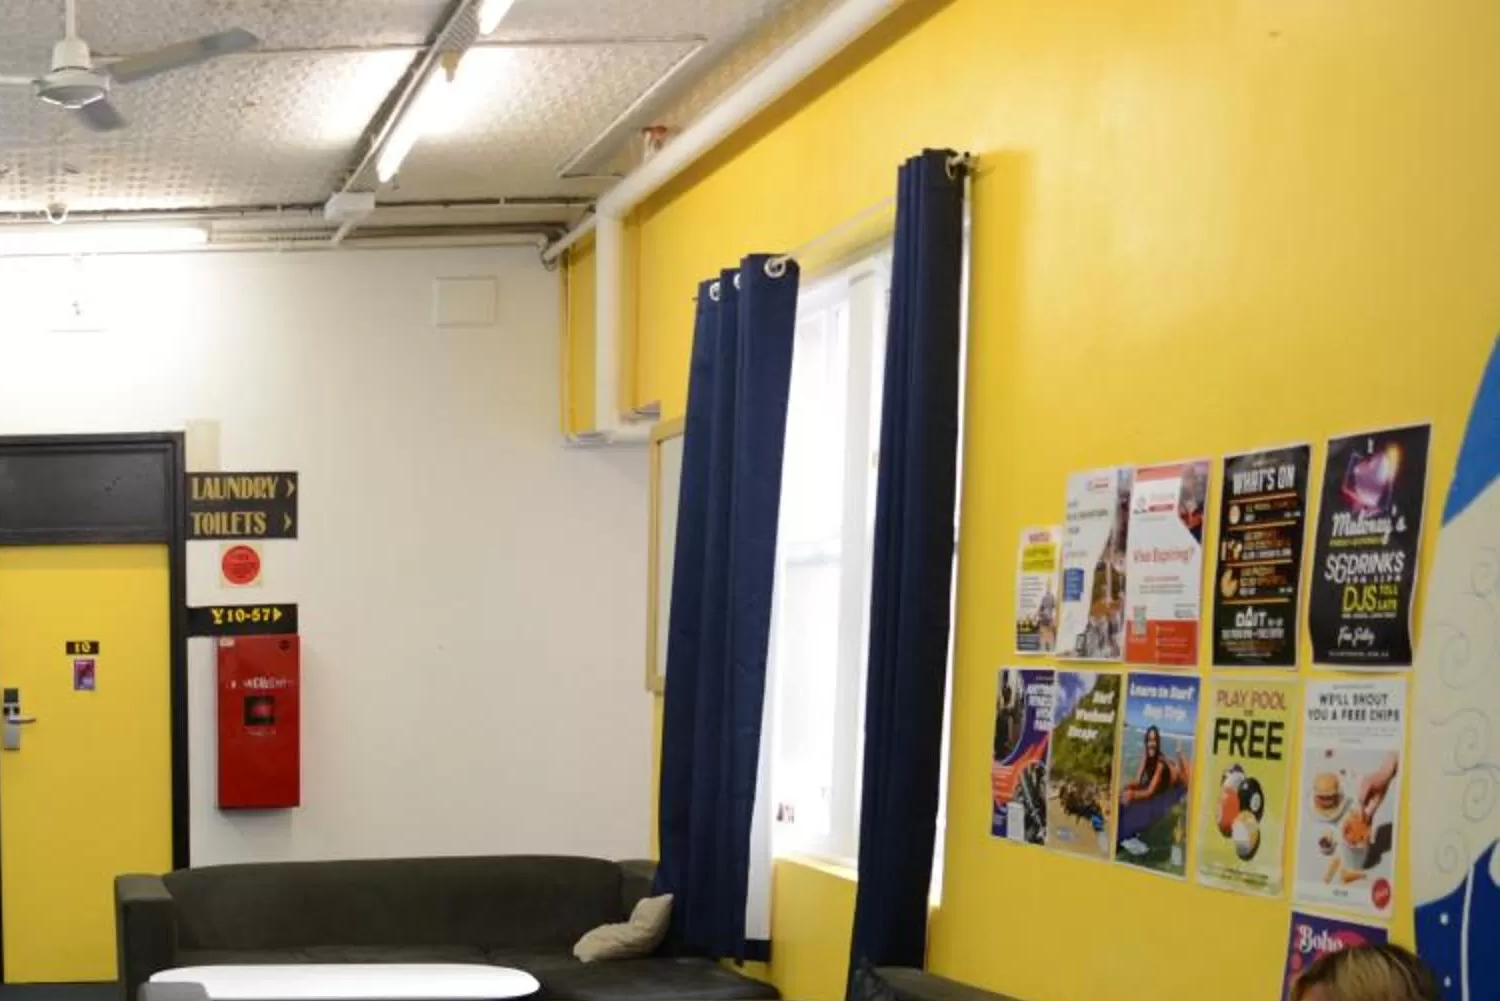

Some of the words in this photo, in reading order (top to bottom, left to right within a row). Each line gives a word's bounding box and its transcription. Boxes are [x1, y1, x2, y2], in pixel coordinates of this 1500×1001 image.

[192, 476, 279, 500] LAUNDRY
[1277, 463, 1295, 489] ON
[190, 511, 267, 536] TOILETS
[1346, 550, 1406, 575] DRINKS
[1342, 584, 1377, 612] DJS
[211, 607, 224, 624] Y
[75, 642, 91, 653] 10
[1217, 689, 1249, 707] PLAY
[1251, 690, 1287, 711] POOL
[1308, 708, 1328, 721] YOU
[1341, 708, 1366, 721] FREE
[1369, 708, 1400, 722] CHIPS
[1212, 717, 1284, 760] FREE
[1298, 924, 1344, 953] Boho
